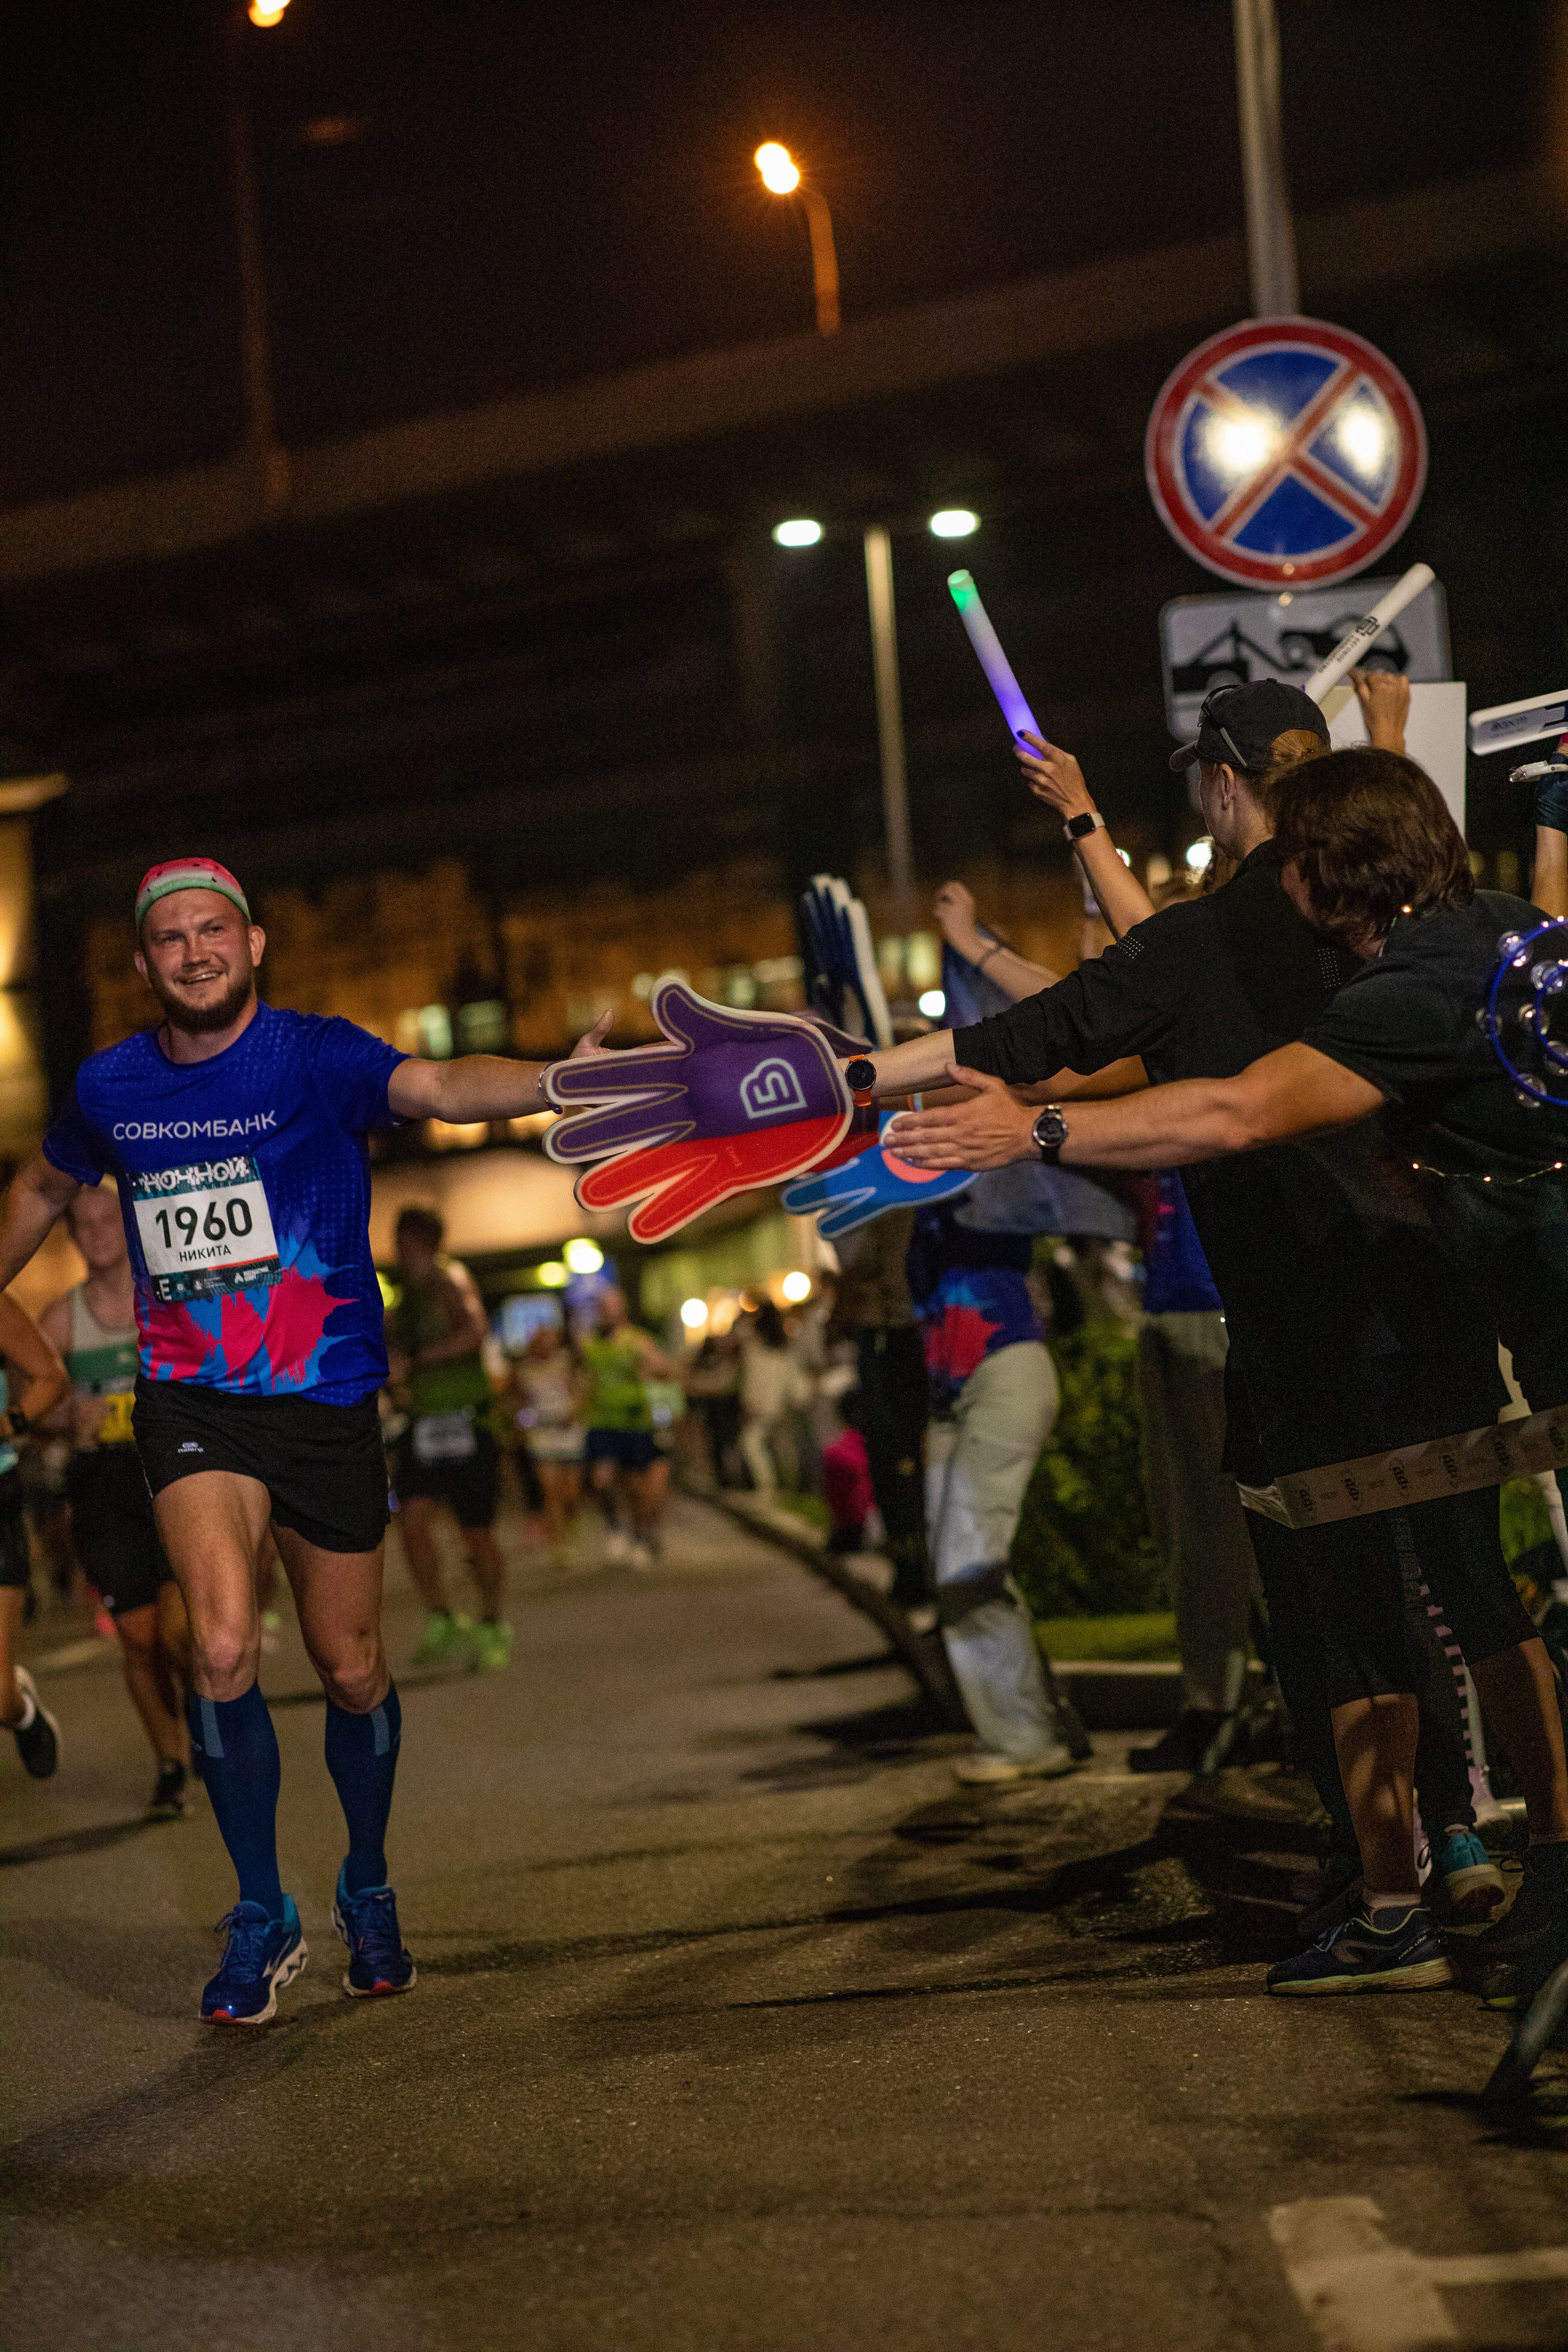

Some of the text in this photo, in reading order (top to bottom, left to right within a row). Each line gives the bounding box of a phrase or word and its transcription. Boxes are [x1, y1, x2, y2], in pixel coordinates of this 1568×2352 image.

[113, 1110, 277, 1140] СОВКОМБАНК
[155, 1197, 253, 1249] 1960
[179, 1245, 232, 1263] НИКИТА
